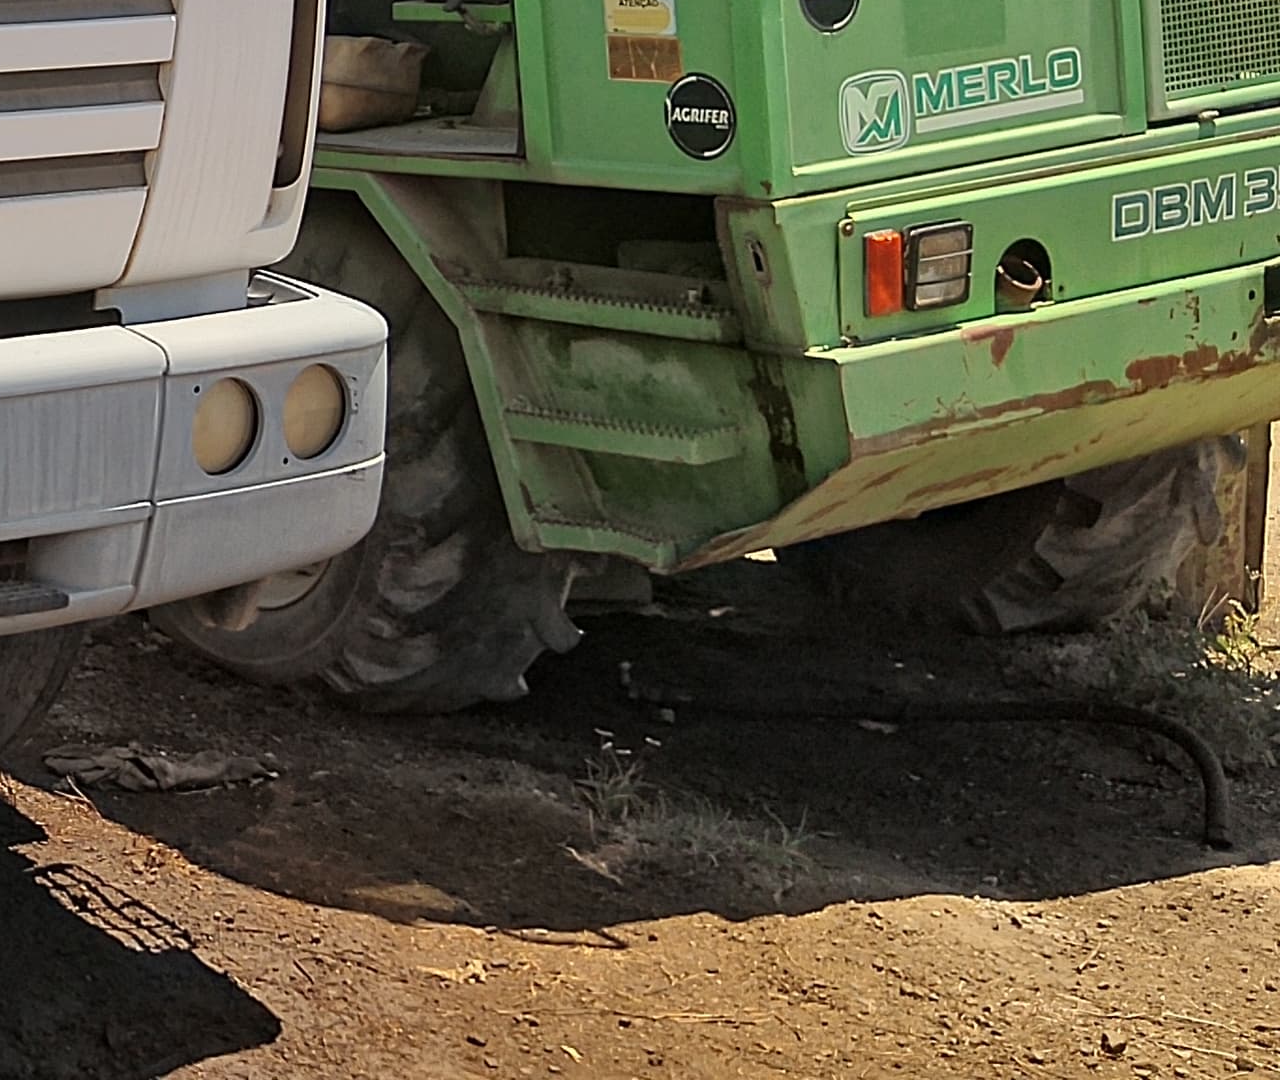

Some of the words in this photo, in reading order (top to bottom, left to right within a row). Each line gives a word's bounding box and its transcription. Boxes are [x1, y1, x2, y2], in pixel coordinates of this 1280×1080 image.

[671, 106, 729, 125] AGRIFER
[914, 47, 1082, 117] MERLO
[1112, 172, 1236, 241] DBM
[1244, 166, 1280, 217] 3
